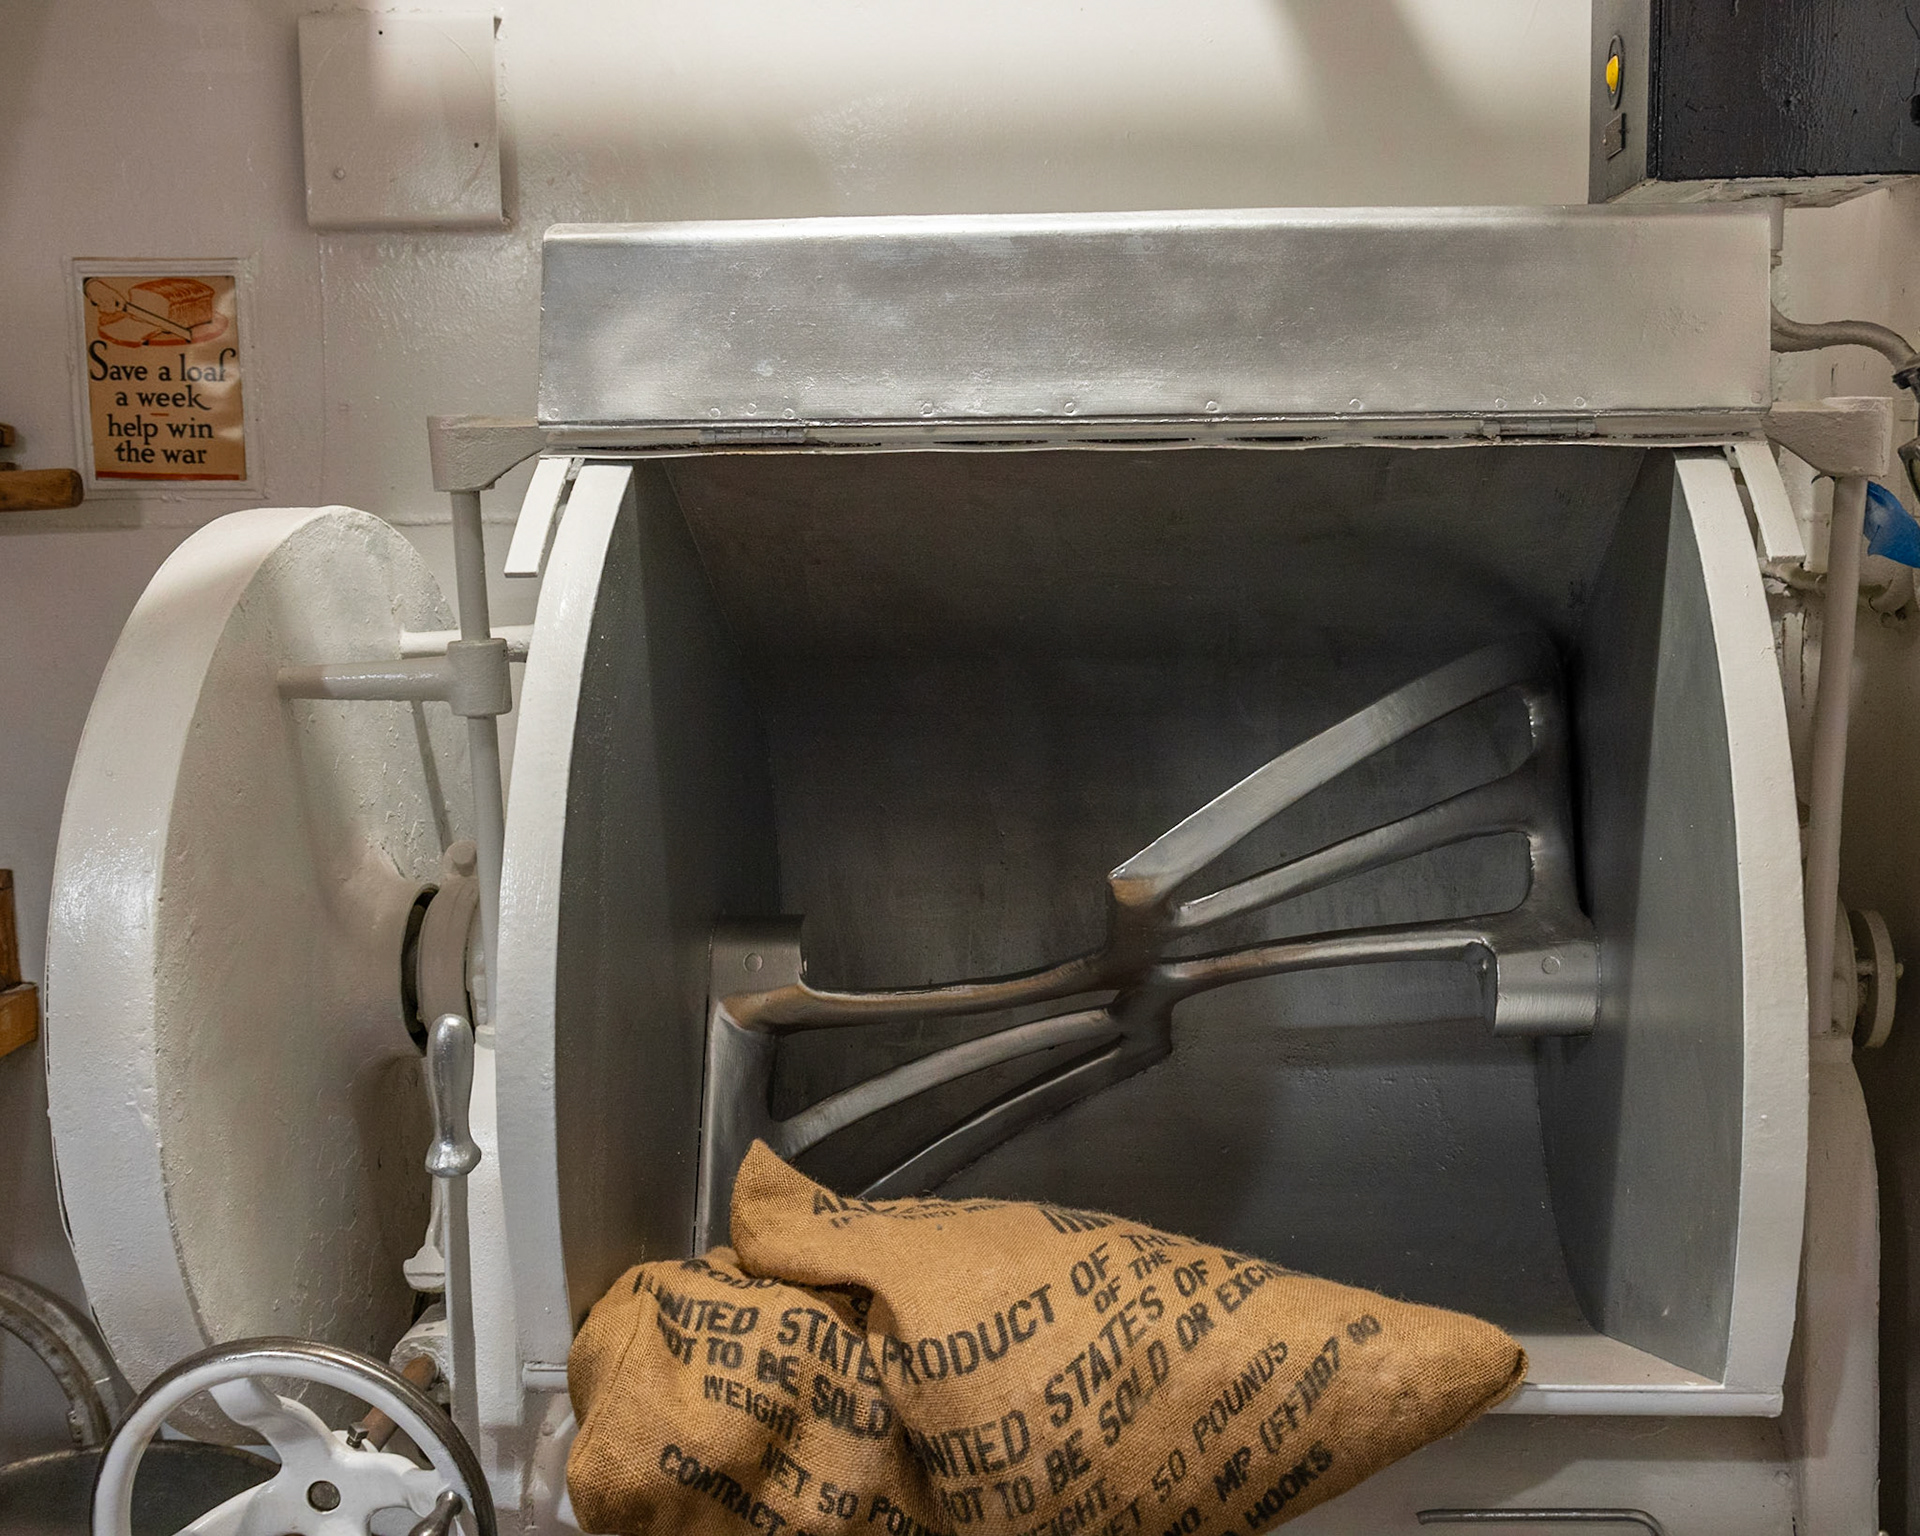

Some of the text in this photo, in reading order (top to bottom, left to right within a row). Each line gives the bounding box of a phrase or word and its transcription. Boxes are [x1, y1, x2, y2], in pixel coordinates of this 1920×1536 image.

[89, 340, 236, 382] Save a loaf
[115, 385, 212, 410] a week
[107, 413, 214, 445] help win
[115, 440, 208, 464] the war
[882, 1283, 1054, 1385] PRODUCT
[1070, 1242, 1110, 1297] OF
[1094, 1249, 1172, 1313] OF THE
[706, 1336, 743, 1369] TO
[757, 1348, 800, 1396] BE
[812, 1373, 892, 1438] SOLD
[905, 1259, 1209, 1478] NITED STATES OF
[994, 1475, 1035, 1520] TO
[1044, 1428, 1092, 1495] BE
[1099, 1339, 1169, 1447] SOLD
[1175, 1302, 1215, 1351] OR
[1152, 1450, 1187, 1502] 50
[1192, 1341, 1288, 1450] POUNDS
[659, 1443, 787, 1536] CONTRACT
[760, 1442, 811, 1498] NET
[1213, 1445, 1251, 1502] MP
[1243, 1440, 1333, 1530] HOOKS
